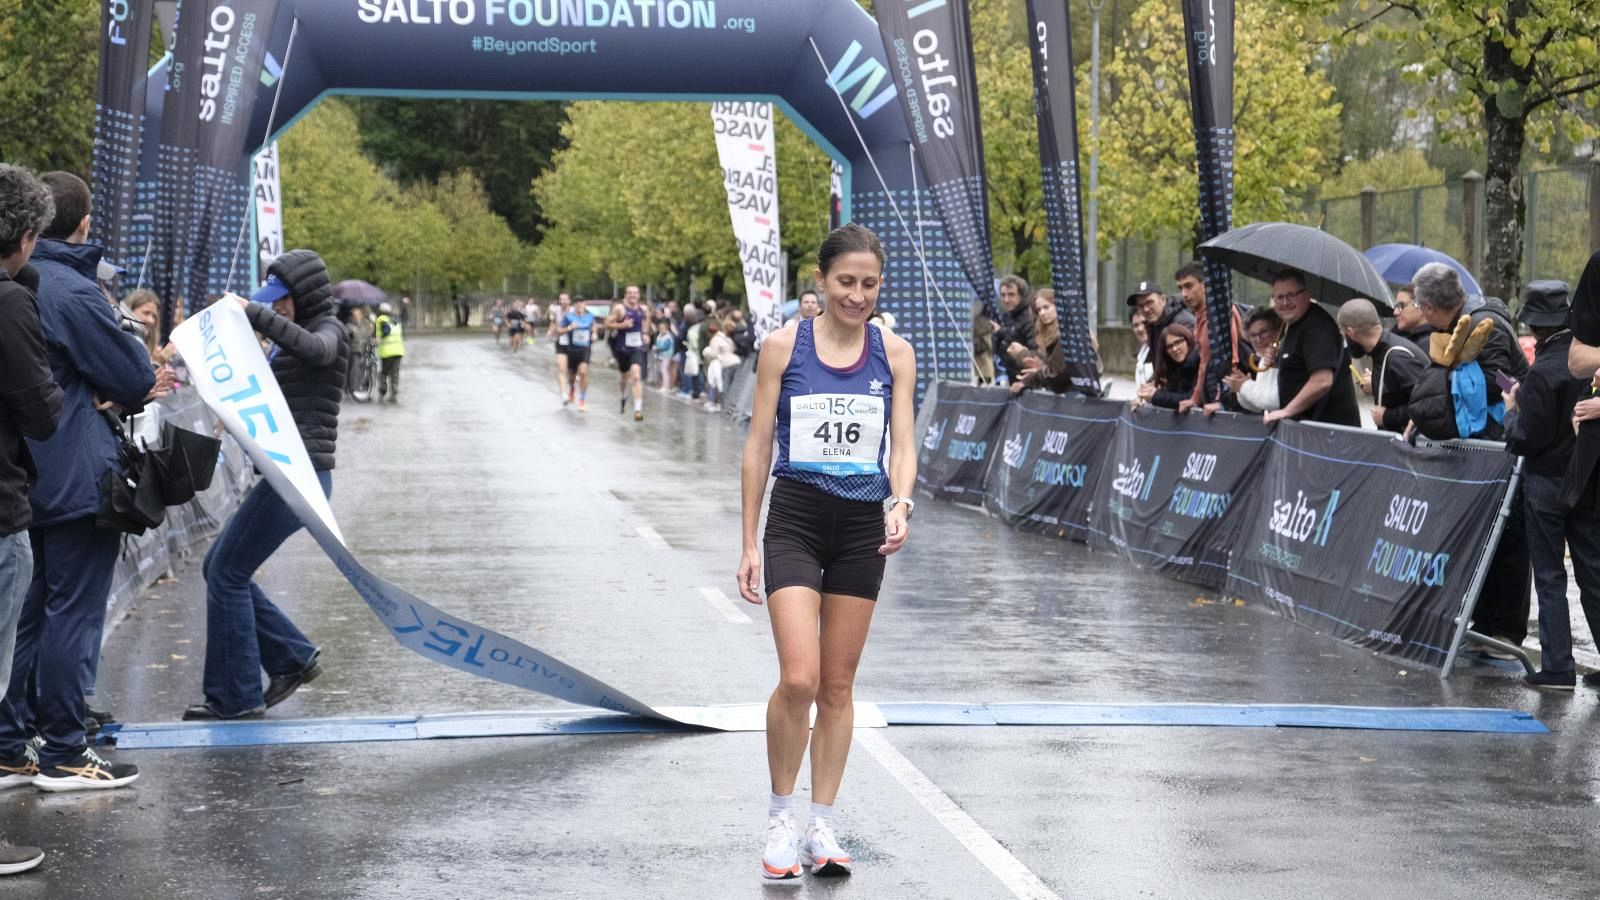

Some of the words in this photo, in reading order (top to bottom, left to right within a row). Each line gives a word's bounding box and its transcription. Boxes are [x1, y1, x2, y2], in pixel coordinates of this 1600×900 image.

[357, 0, 475, 25] SALTO
[486, 0, 716, 28] FOUNDATION
[723, 17, 755, 33] .org
[199, 5, 235, 122] salto
[471, 36, 597, 55] #BeyondSport
[221, 66, 243, 125] INSPIRED
[235, 12, 256, 64] ACCESS
[198, 310, 233, 384] SALTO
[826, 397, 855, 415] 15K
[813, 421, 862, 444] 416
[822, 447, 852, 456] ELENA
[1182, 451, 1217, 482] SALTO
[1269, 489, 1317, 543] salto
[1385, 494, 1429, 535] SALTO
[489, 647, 577, 690] SALTO
